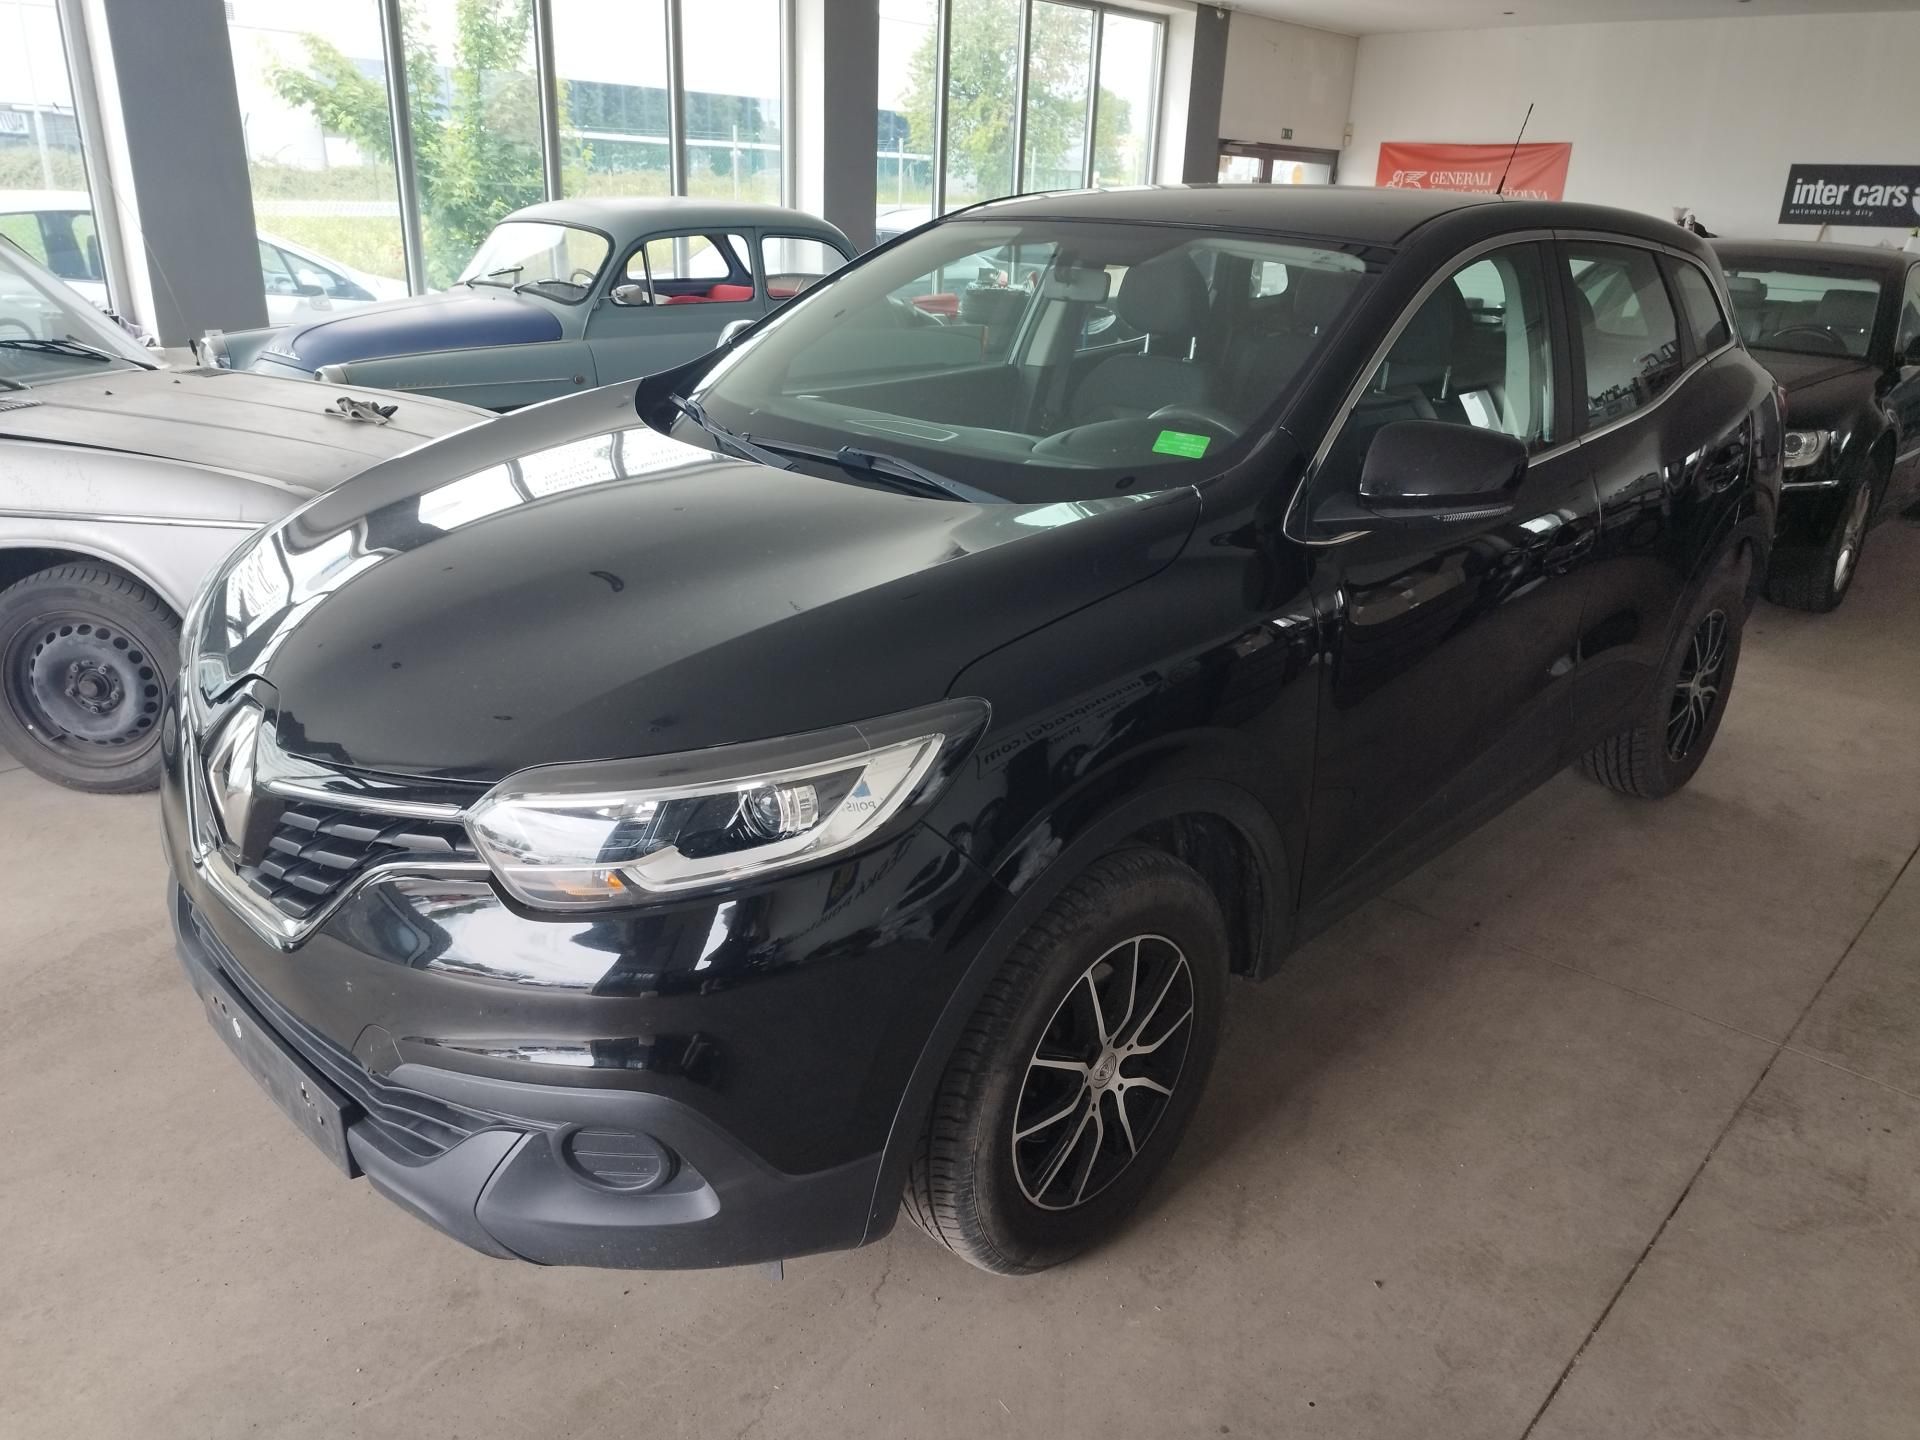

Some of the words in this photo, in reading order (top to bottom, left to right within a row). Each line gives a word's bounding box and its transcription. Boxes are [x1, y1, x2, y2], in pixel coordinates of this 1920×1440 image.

[1430, 172, 1492, 186] GENERALI
[1791, 178, 1850, 206] inter
[1853, 184, 1909, 207] cars
